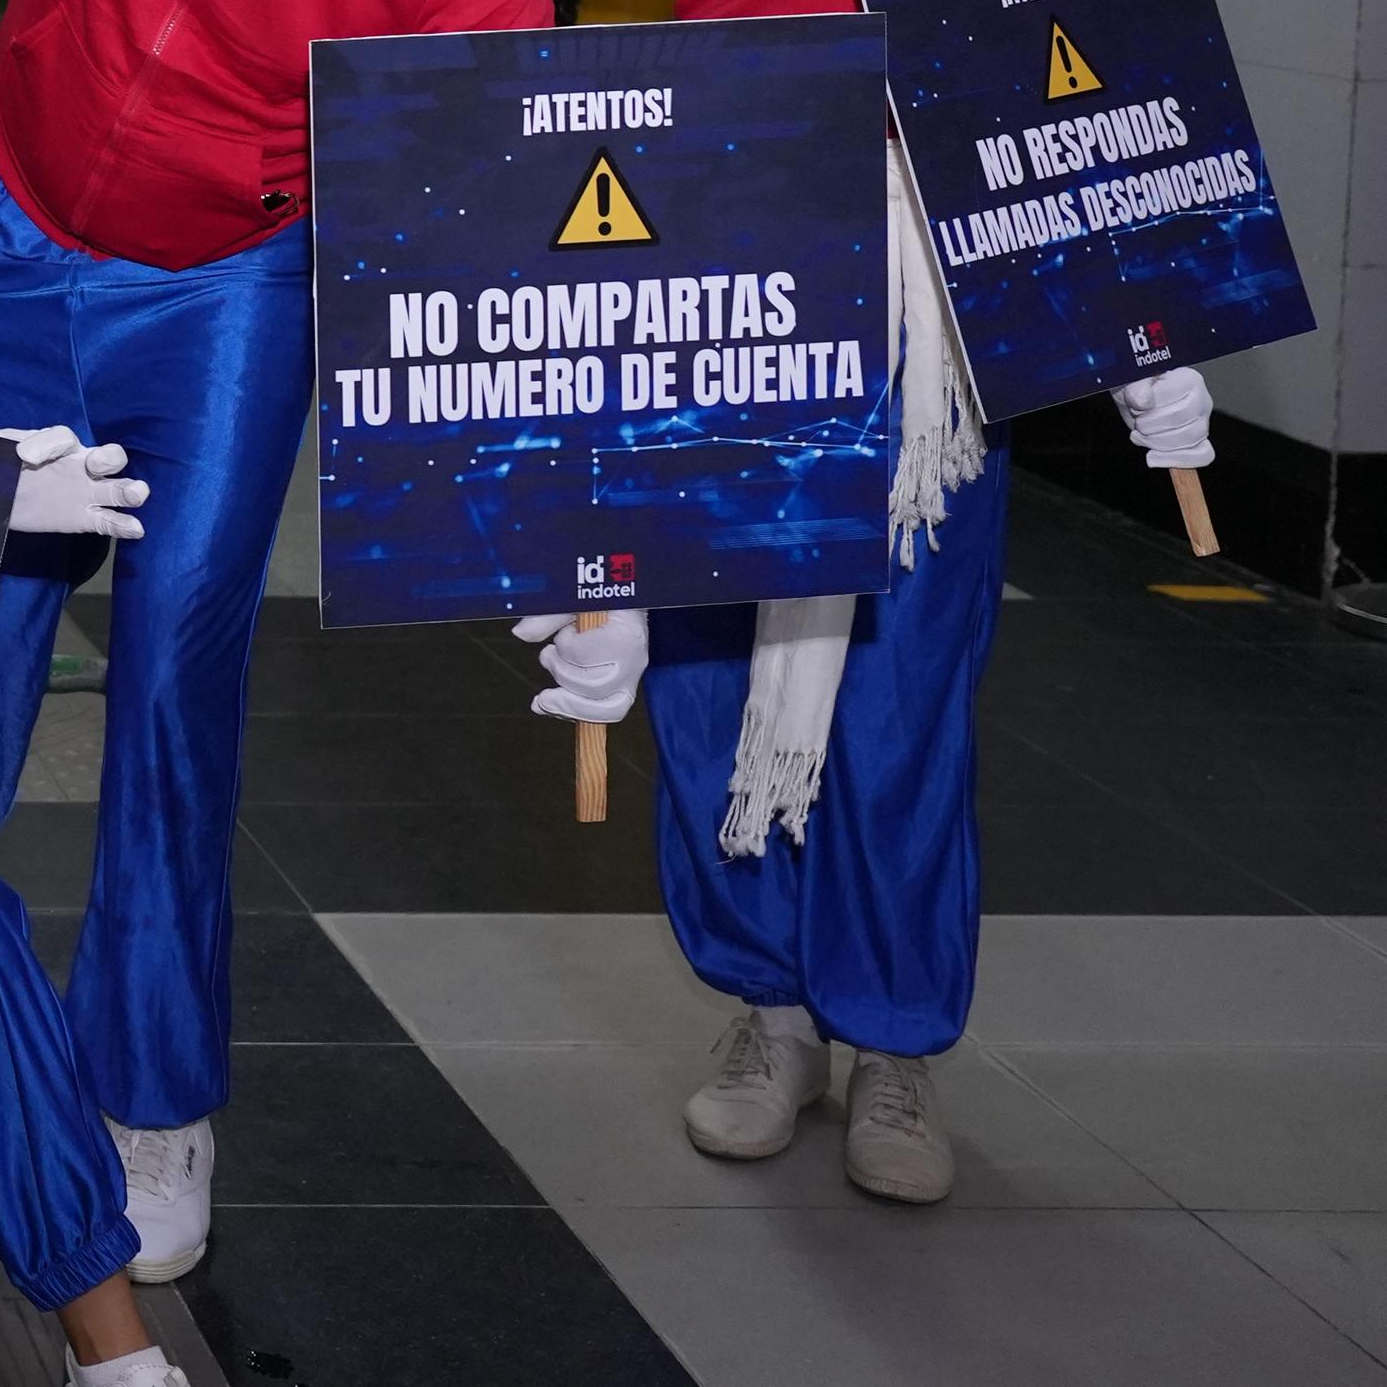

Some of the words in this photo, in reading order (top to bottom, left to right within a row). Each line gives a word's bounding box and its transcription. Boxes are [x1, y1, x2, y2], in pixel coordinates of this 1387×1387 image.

[523, 88, 673, 136] ¡ATENTOS!
[975, 135, 1024, 191] NO
[1023, 96, 1189, 180] RESPONDAS
[939, 192, 1082, 267] LLAMADAS
[1083, 149, 1257, 229] DESCONOCIDAS
[389, 291, 458, 358] NO
[477, 272, 797, 354] COMPARTAS
[1134, 346, 1171, 367] indotel
[335, 368, 391, 427] TU
[408, 357, 604, 423] NUMERO
[621, 351, 677, 411] DE
[693, 340, 864, 407] CUENTA
[577, 582, 635, 599] indotel
